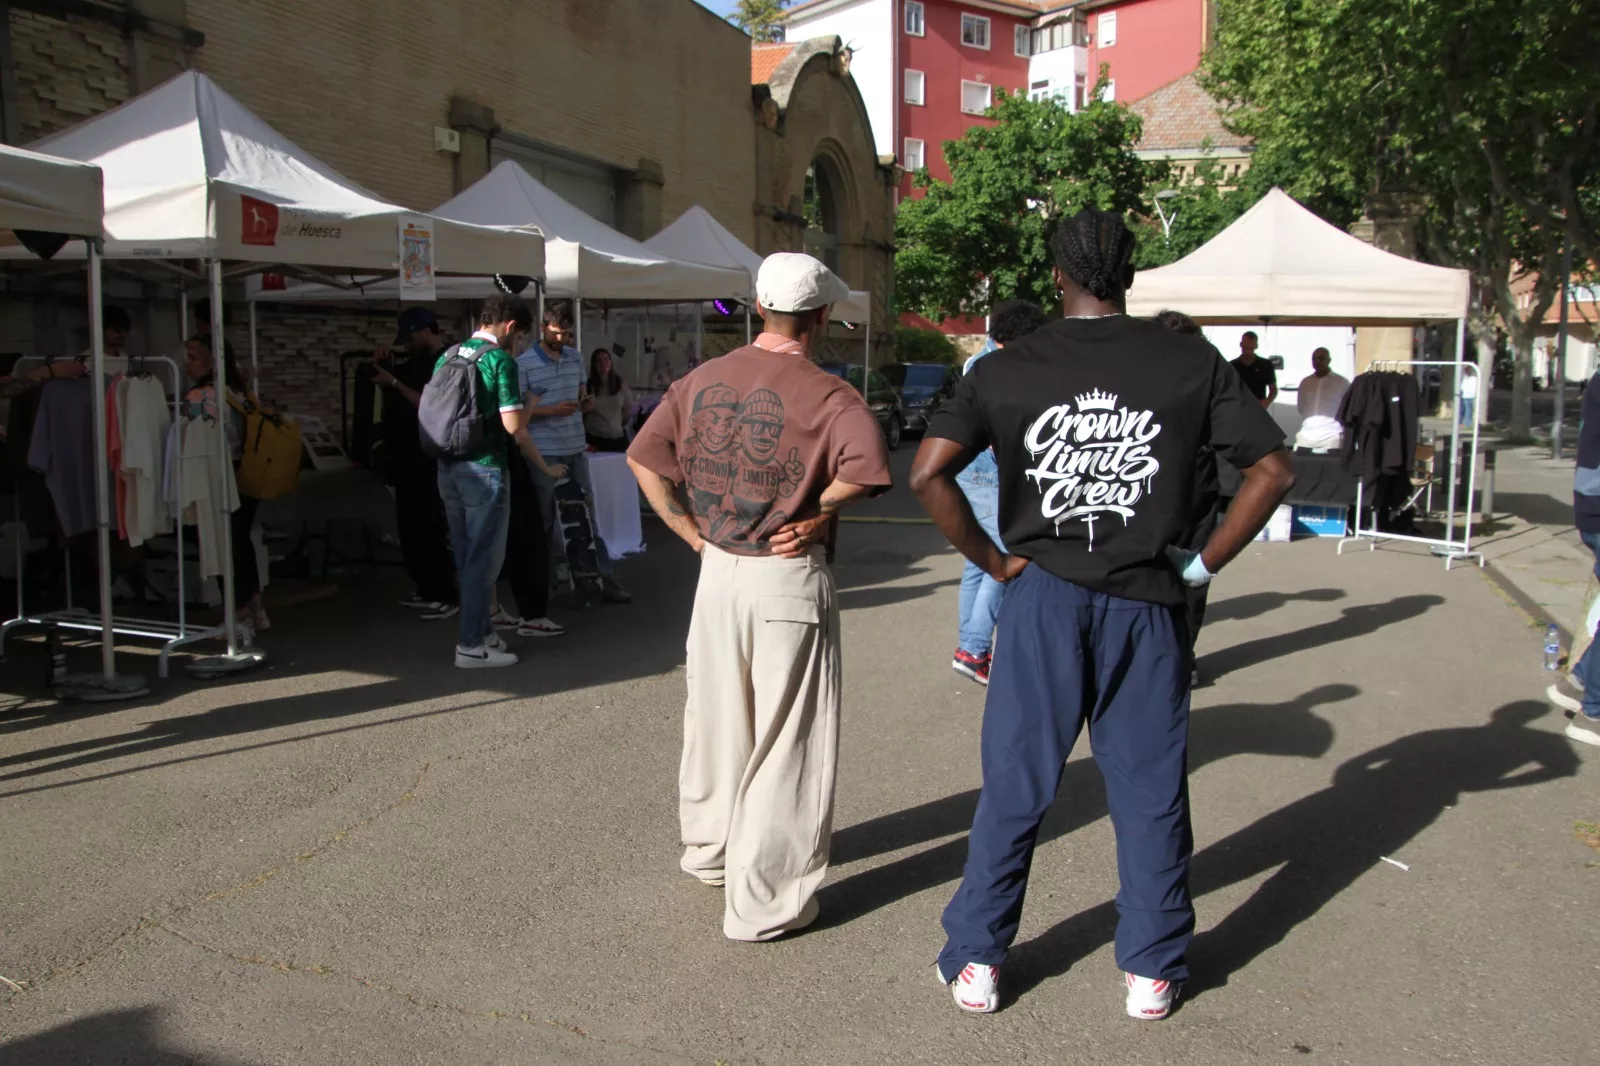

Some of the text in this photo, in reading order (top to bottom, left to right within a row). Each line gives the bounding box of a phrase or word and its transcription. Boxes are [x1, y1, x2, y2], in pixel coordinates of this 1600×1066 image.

[281, 222, 342, 239] de Huesca
[1024, 404, 1162, 455] Crown
[699, 457, 777, 487] CROWN LIMITS
[1024, 437, 1160, 486] Limits
[1041, 476, 1143, 519] Crew
